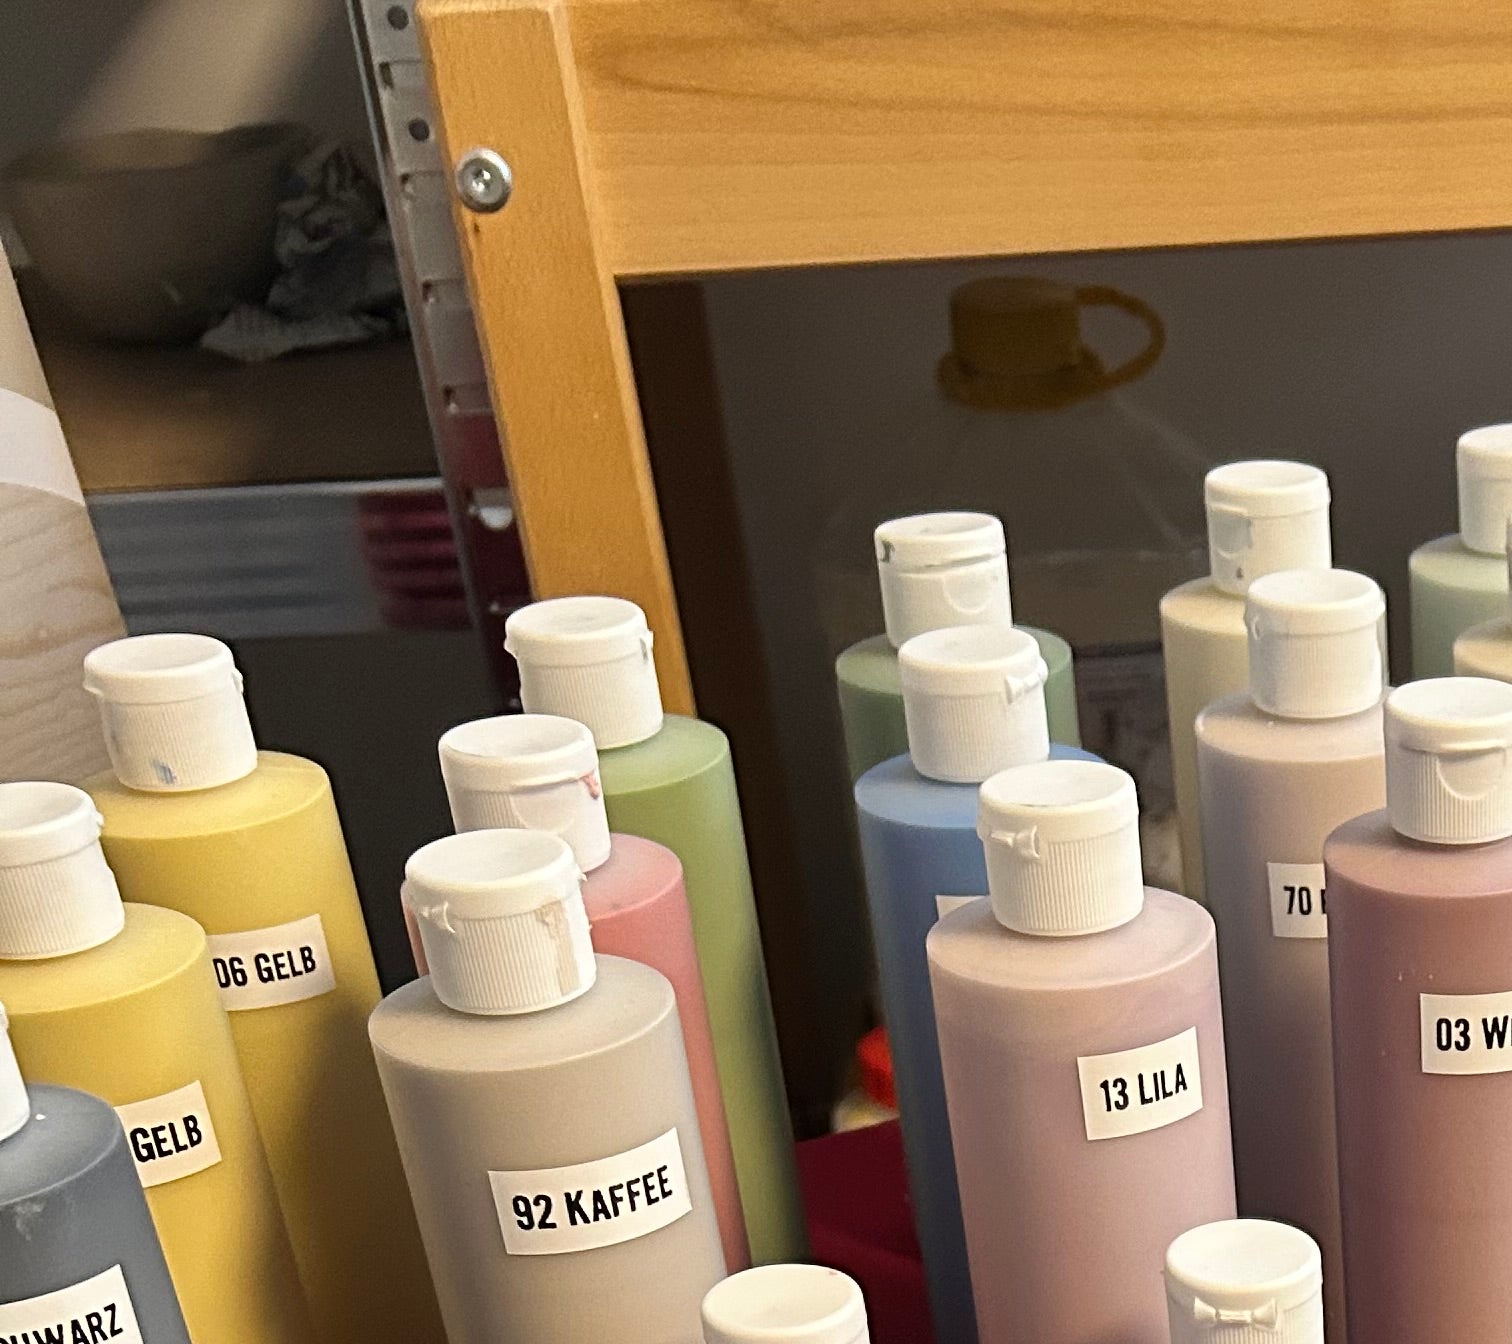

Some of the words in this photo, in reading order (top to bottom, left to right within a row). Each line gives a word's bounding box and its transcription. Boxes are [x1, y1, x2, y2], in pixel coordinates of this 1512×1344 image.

[1284, 886, 1311, 915] 70
[213, 957, 247, 988] 06
[255, 947, 316, 983] GELB
[1437, 1018, 1470, 1051] 03
[1100, 1078, 1128, 1111] 13
[1138, 1064, 1187, 1105] LILA
[130, 1115, 202, 1163] GELB
[513, 1195, 557, 1230] 92
[564, 1165, 672, 1225] KAFFEE
